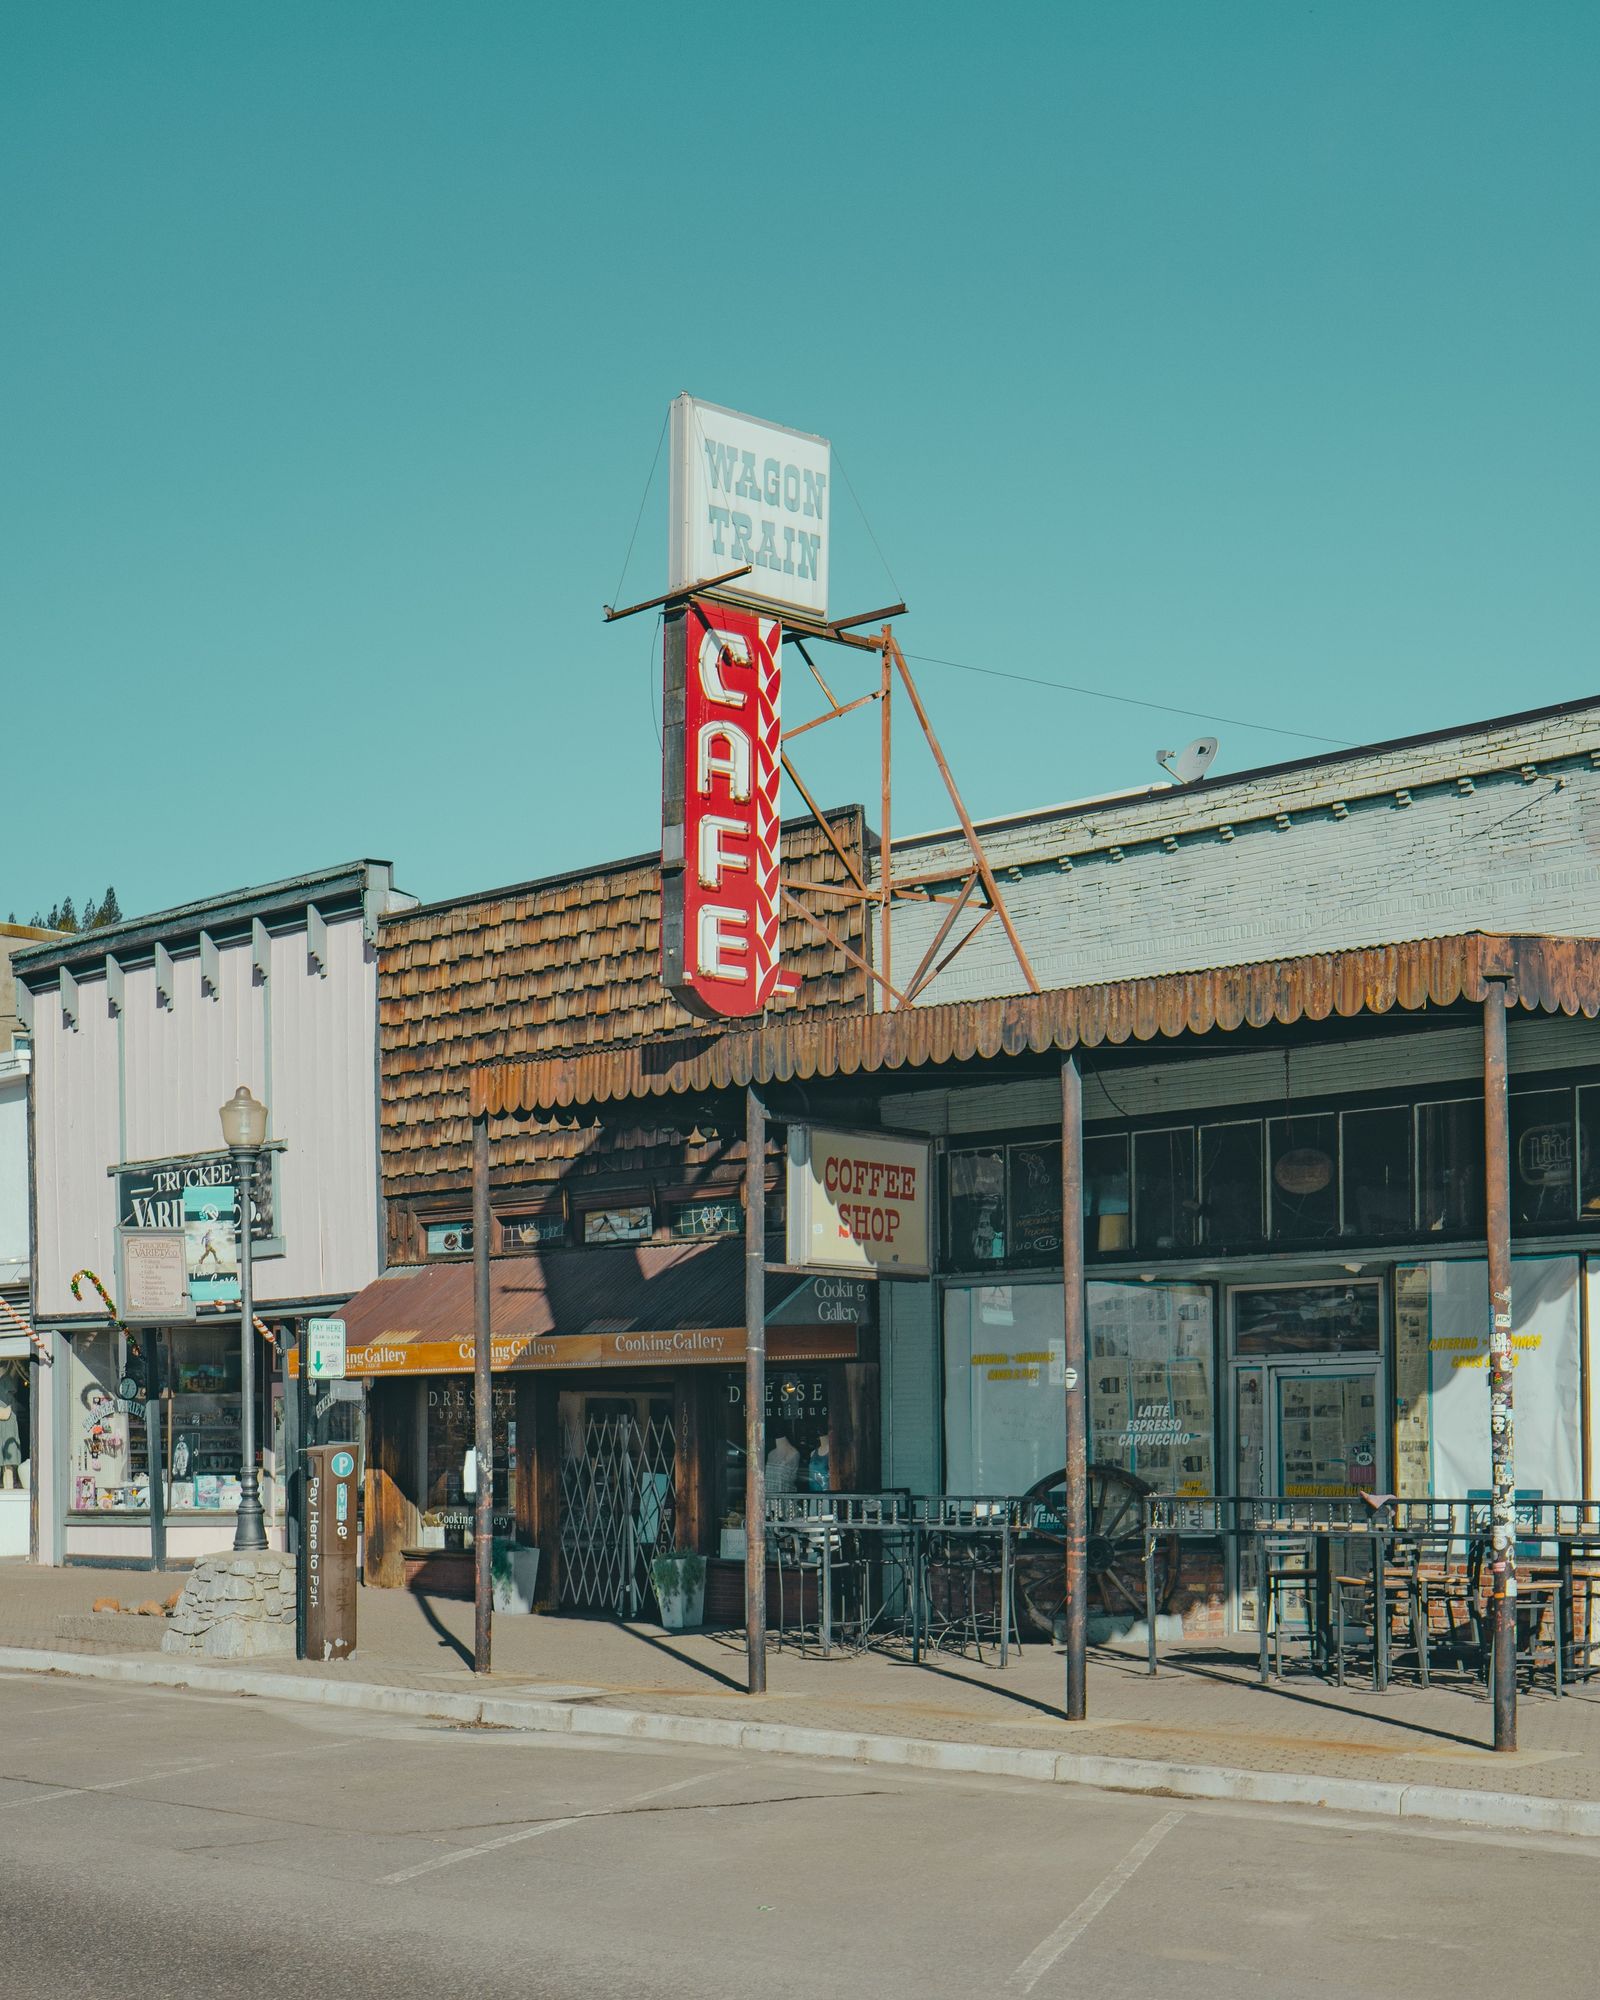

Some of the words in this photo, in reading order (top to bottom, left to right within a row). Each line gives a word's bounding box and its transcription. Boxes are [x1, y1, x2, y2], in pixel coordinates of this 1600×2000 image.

[704, 439, 827, 520] WAGON
[708, 506, 821, 581] TRAIN
[696, 629, 754, 981] CAFE
[153, 1163, 233, 1193] TRUCKEE
[825, 1156, 916, 1201] COFFEE
[838, 1203, 901, 1243] SHOP
[135, 1248, 169, 1259] VARIETY
[818, 1301, 860, 1323] Gallery
[346, 1347, 408, 1365] ingGallery
[459, 1340, 557, 1360] CoingGallery
[117, 1399, 147, 1422] VARIET
[743, 1404, 829, 1419] butique
[1126, 1419, 1182, 1432] ESPRESSO
[1118, 1433, 1190, 1446] CAPPUCCINO
[308, 1477, 320, 1507] Pay
[309, 1511, 320, 1550] Here
[437, 1512, 474, 1527] Cooking
[309, 1554, 320, 1570] to
